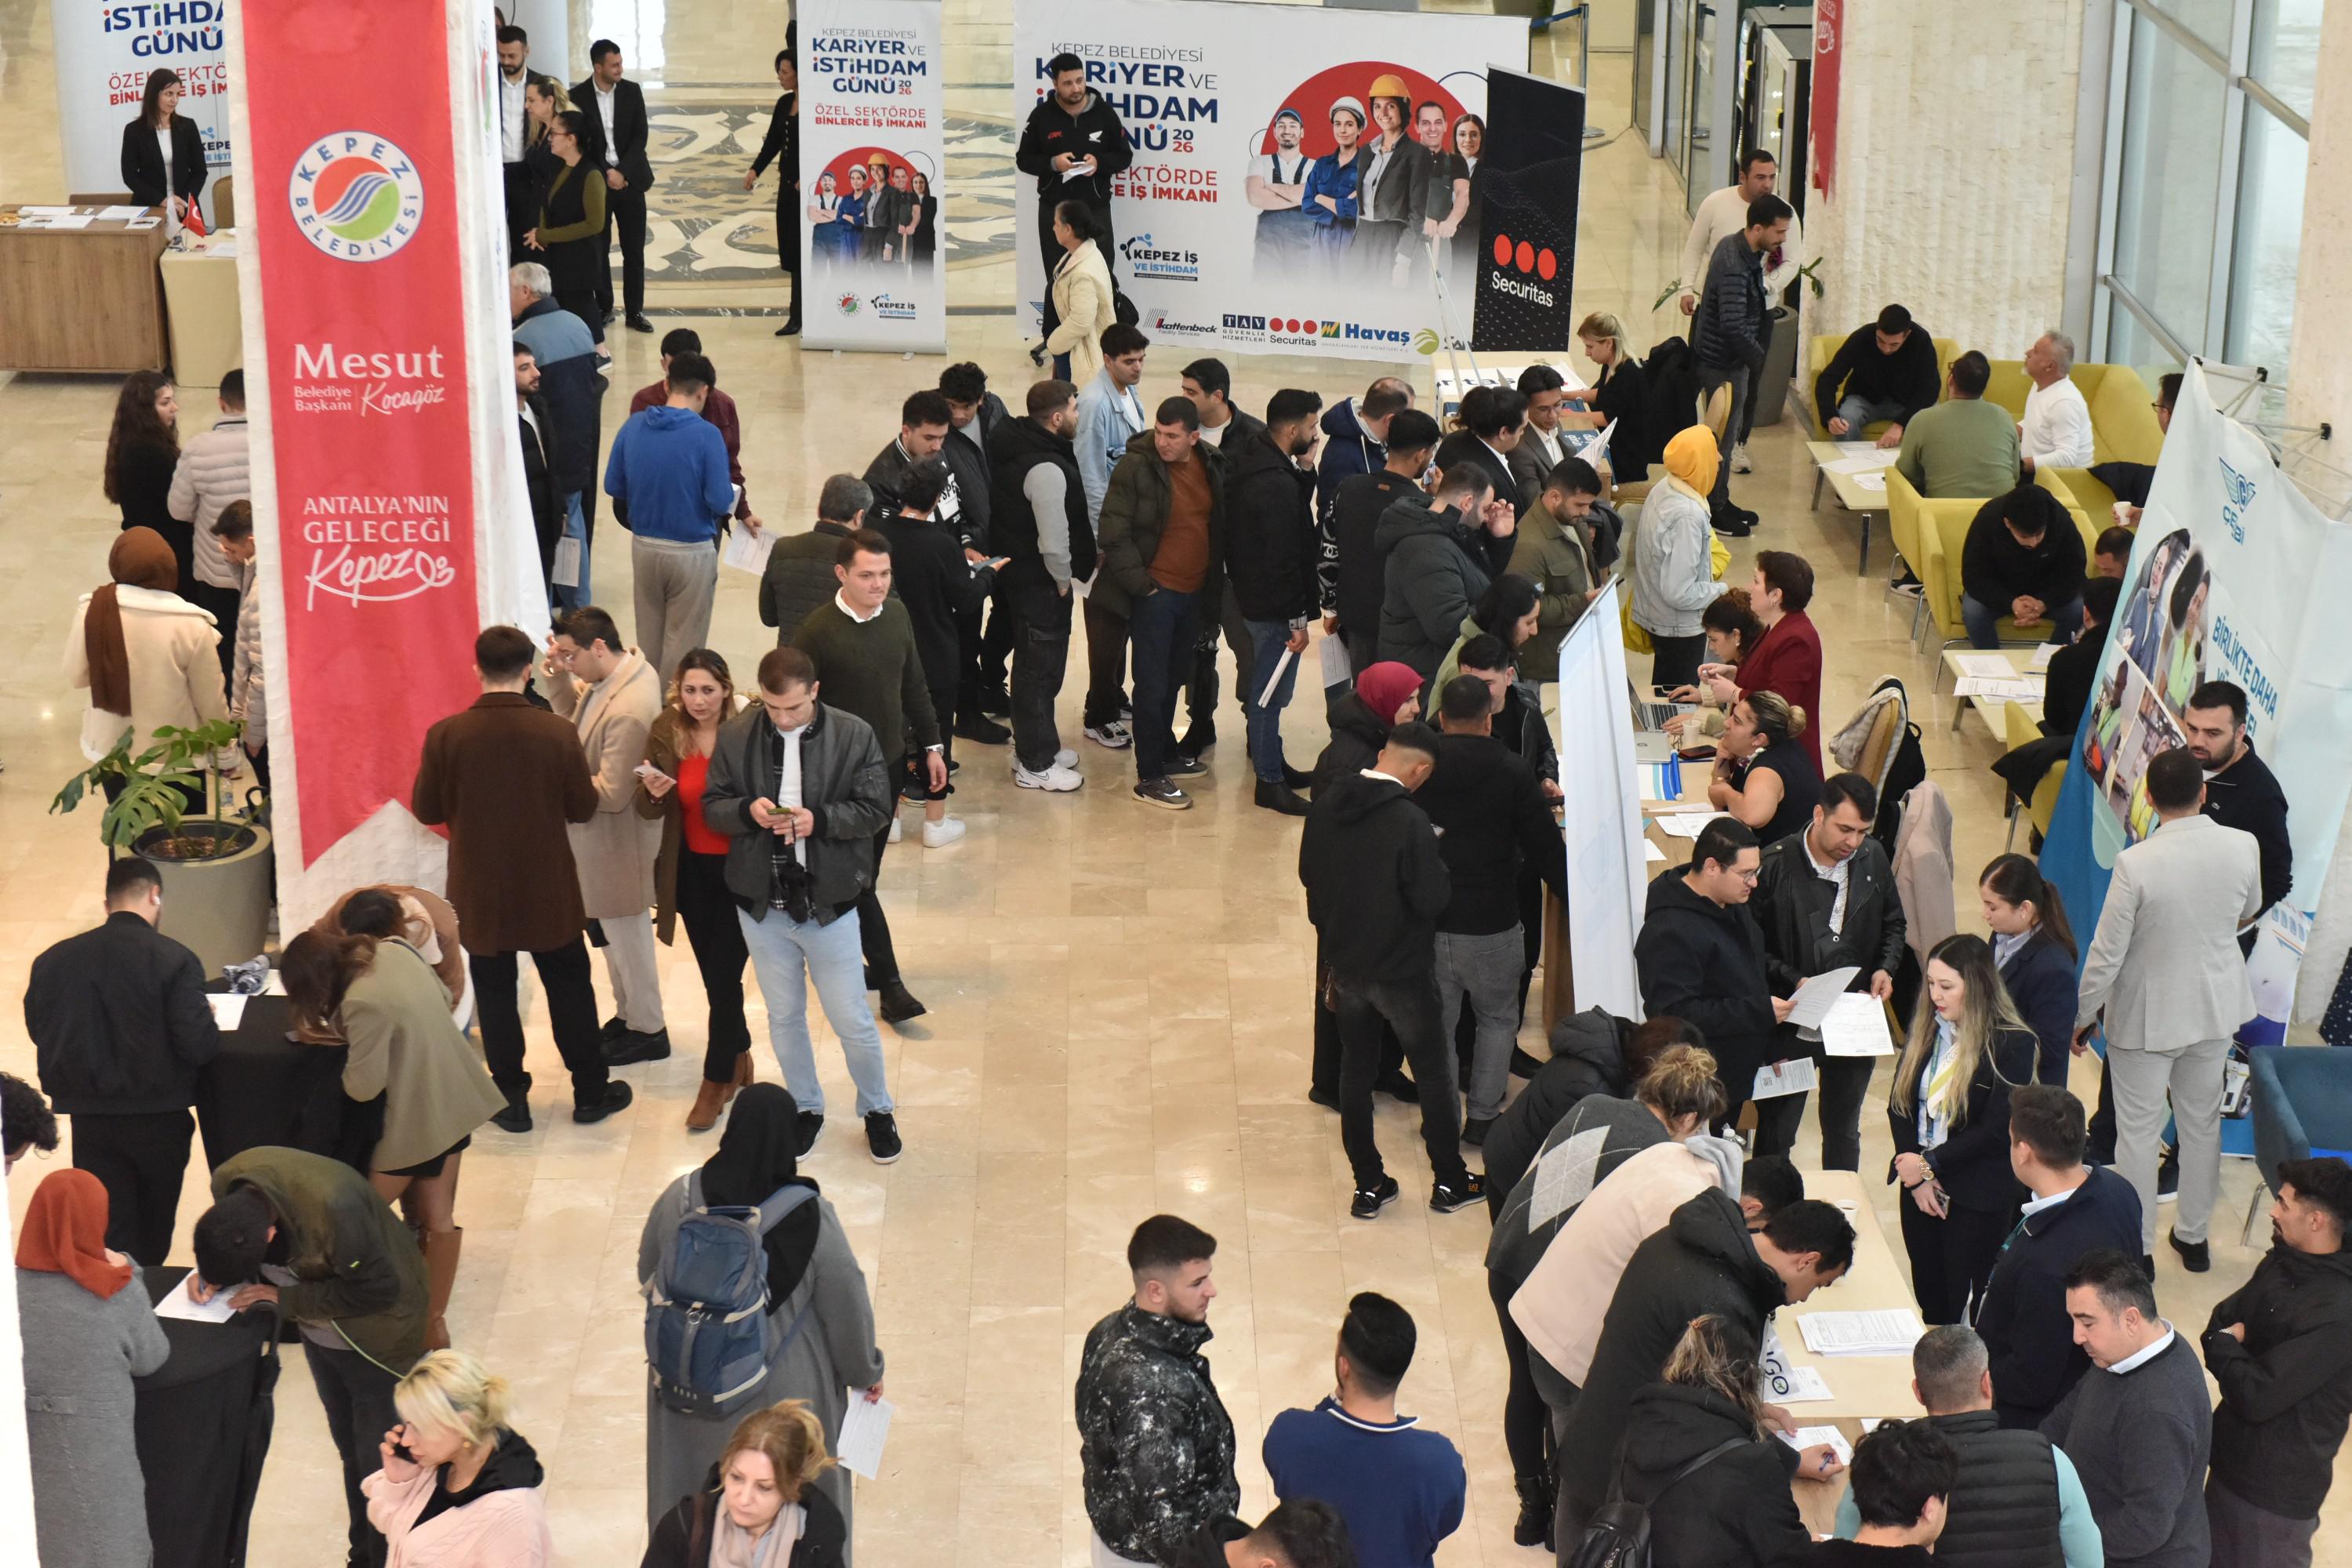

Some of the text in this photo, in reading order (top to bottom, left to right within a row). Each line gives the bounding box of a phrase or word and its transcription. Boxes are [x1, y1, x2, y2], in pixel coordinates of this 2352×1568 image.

[132, 26, 223, 56] GÜNÜ
[822, 28, 916, 39] KEPEZ BELEDİYESİ
[908, 45, 926, 56] VE
[1052, 42, 1203, 62] KEPEZ BELEDİYESİ
[109, 61, 227, 89] ÖZE EKTÖ
[1036, 57, 1218, 90] KRİYER VE
[191, 82, 207, 97] İŞ
[833, 76, 895, 94] GÜNÜ
[815, 103, 927, 118] ÖZEL SEKTÖRDE
[815, 115, 927, 129] BİNLERCE İŞ İMKANI
[1172, 129, 1194, 140] 20
[1172, 141, 1194, 153] 26
[298, 136, 411, 183] KEPEZ
[1116, 164, 1218, 186] EKTÖRDE
[1131, 182, 1147, 200] İŞ
[1152, 183, 1218, 203] İMKANI
[1134, 249, 1198, 264] KEPEZ İŞ
[1149, 262, 1198, 274] İSTİHDAM
[1492, 270, 1553, 307] Securitas
[1224, 315, 1265, 329] TAV
[1269, 335, 1317, 347] Securitas
[1345, 323, 1410, 347] Havaş
[294, 343, 445, 379] Mesut
[293, 385, 352, 401] Belediye
[361, 381, 445, 417] Kocagöz
[295, 399, 352, 414] Başkanı
[303, 495, 449, 515] ANTALYA'NIN
[303, 517, 451, 543] GELECEĞİ
[304, 543, 416, 612] Kepez
[2212, 615, 2253, 684] BİRLİKTE
[2249, 666, 2278, 720] DAHA
